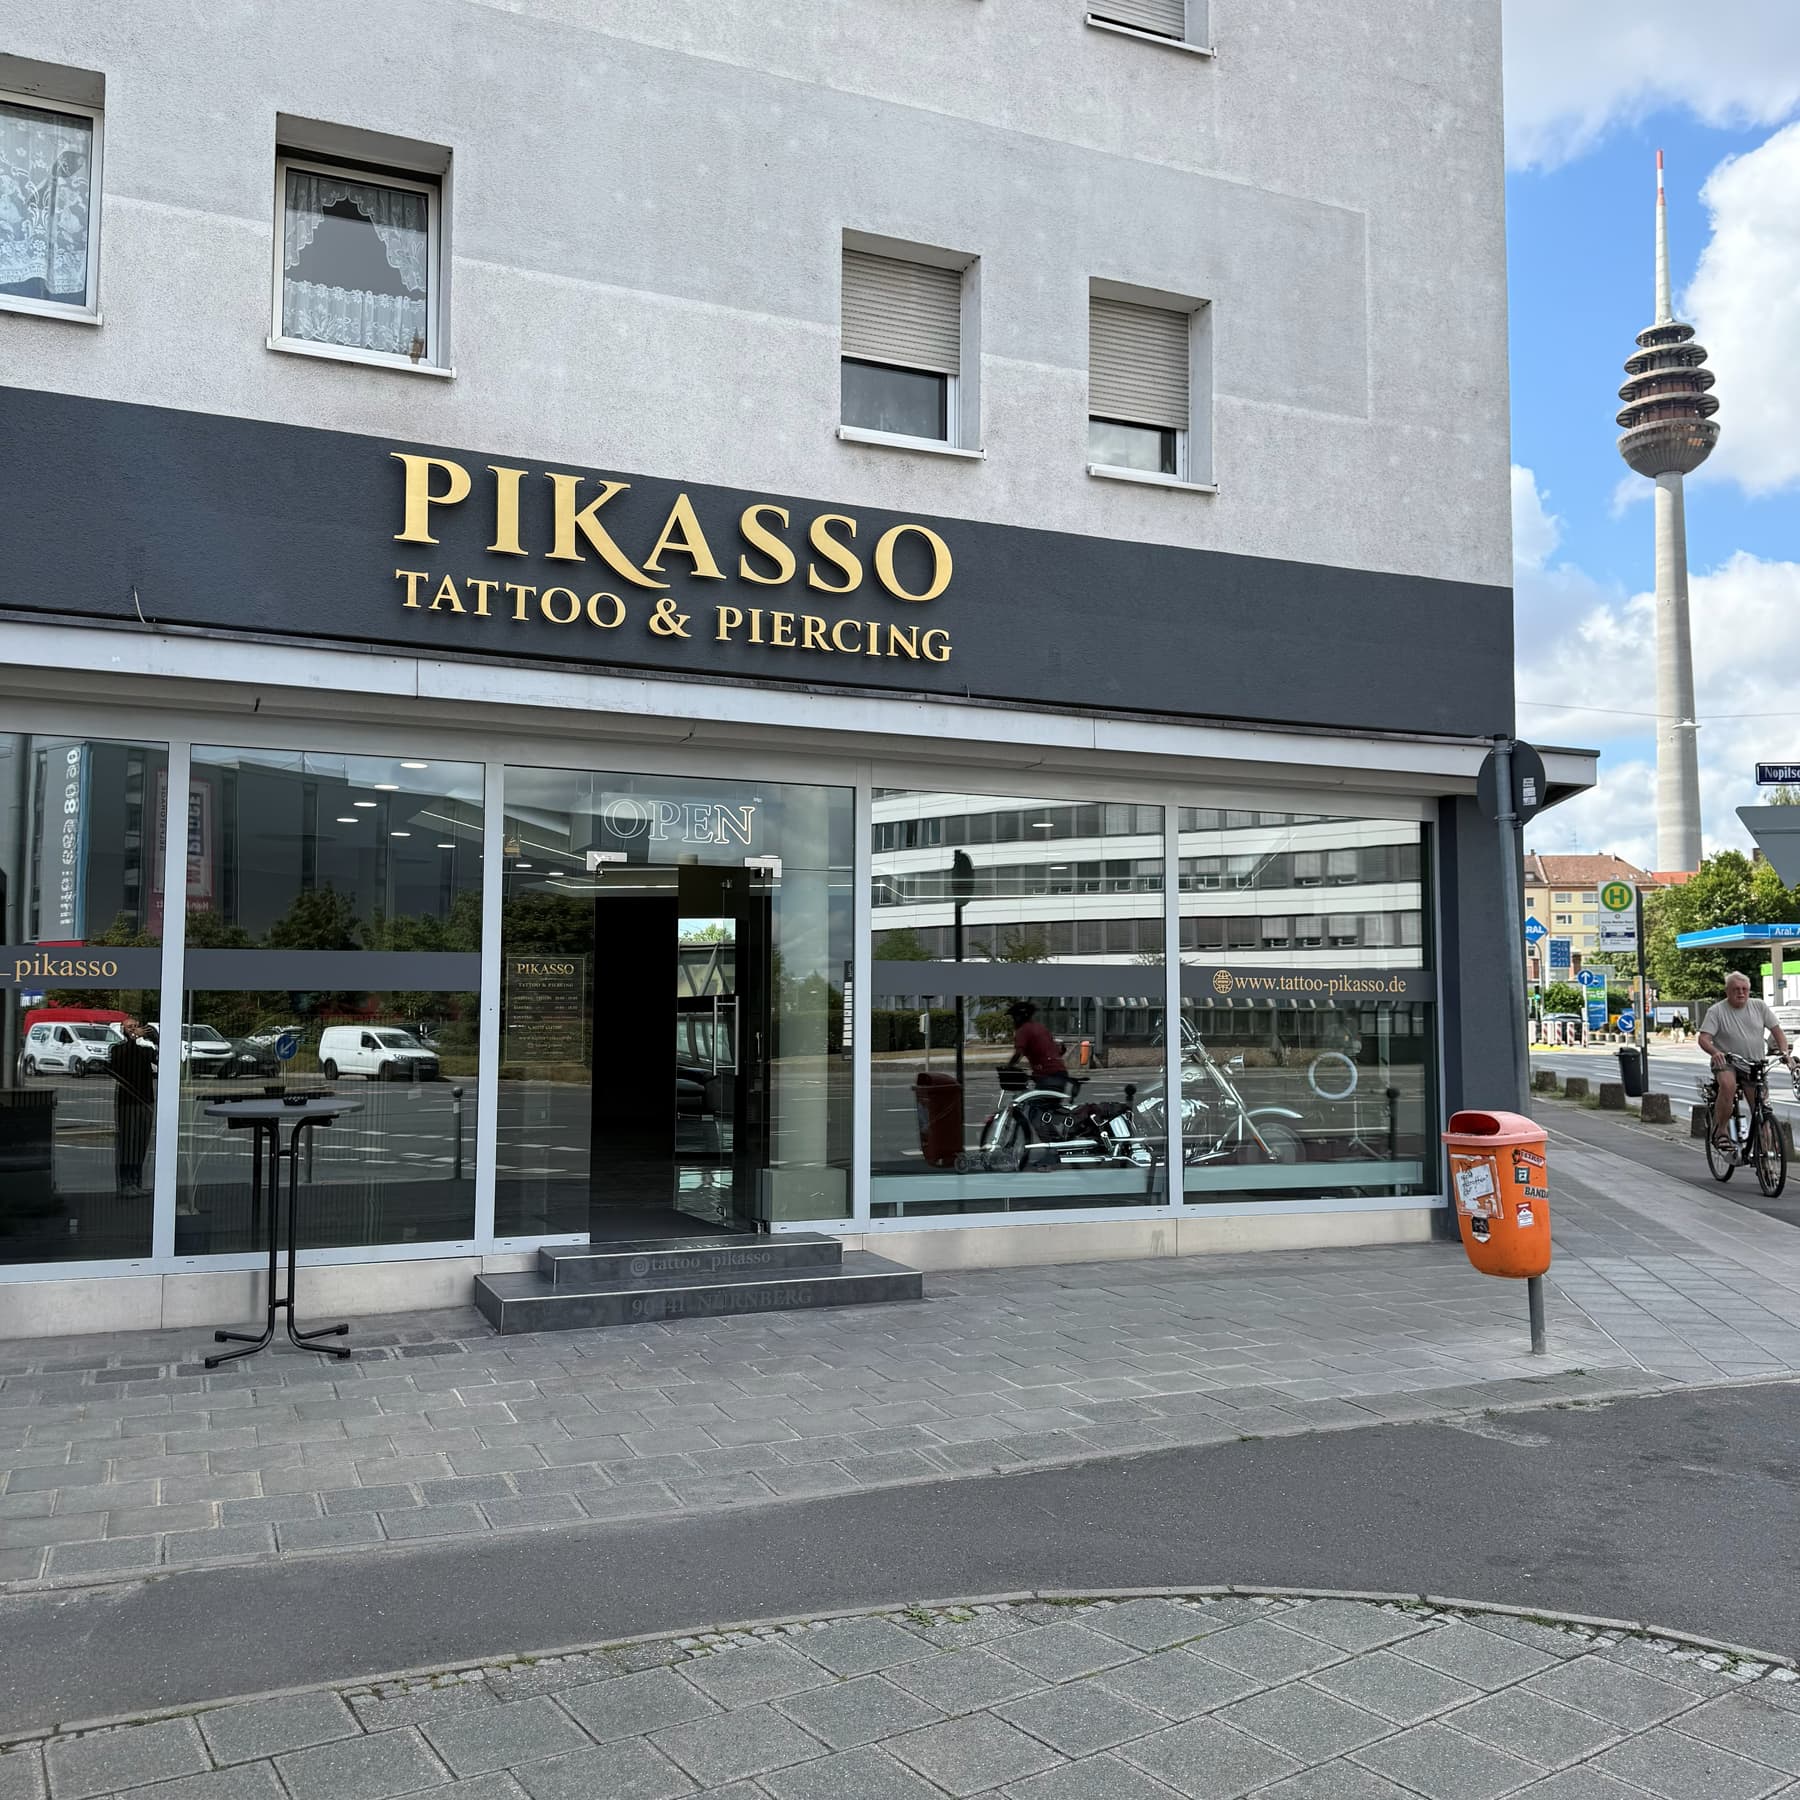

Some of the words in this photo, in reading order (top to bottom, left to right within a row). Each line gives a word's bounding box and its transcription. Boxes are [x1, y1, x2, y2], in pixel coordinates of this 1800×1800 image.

[390, 451, 953, 601] PIKASSO
[395, 569, 626, 625] TATTOO
[648, 598, 692, 638] &
[715, 605, 953, 663] PIERCING
[604, 799, 756, 845] OPEN
[1609, 888, 1625, 905] H
[1525, 925, 1545, 934] RAL
[517, 963, 575, 975] PIKASSO
[1234, 974, 1407, 996] www.tattoo-pikasso.de
[651, 1251, 771, 1273] tattoo_pikasso
[699, 1287, 812, 1312] NÜRNBERG
